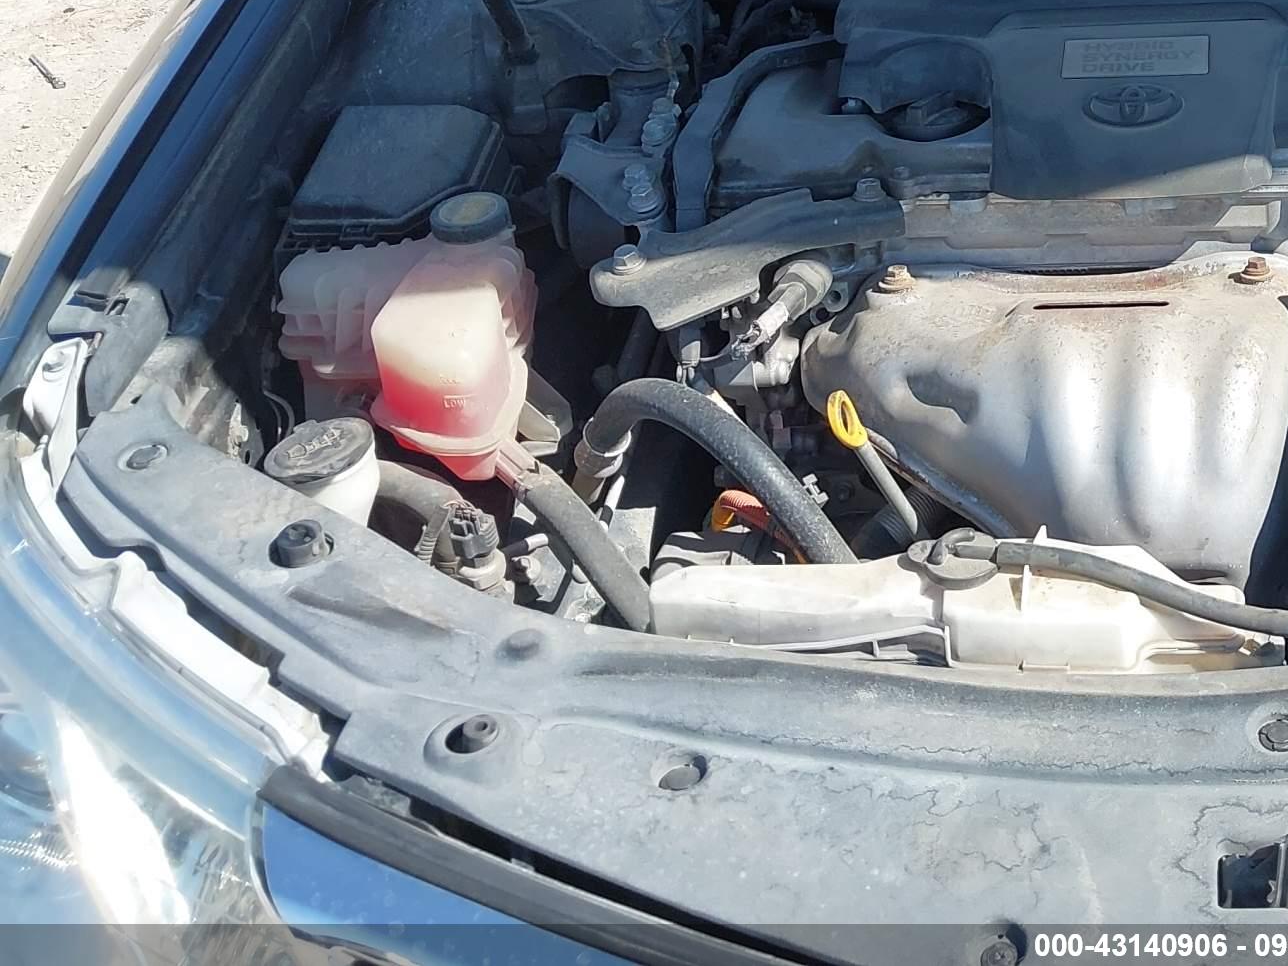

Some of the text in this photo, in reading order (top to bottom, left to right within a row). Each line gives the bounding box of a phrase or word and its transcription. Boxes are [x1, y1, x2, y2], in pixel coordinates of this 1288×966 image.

[1084, 41, 1174, 52] HYBRID
[1081, 49, 1195, 63] SYNERGY
[1081, 61, 1155, 73] DRIVE
[443, 398, 466, 410] LOW
